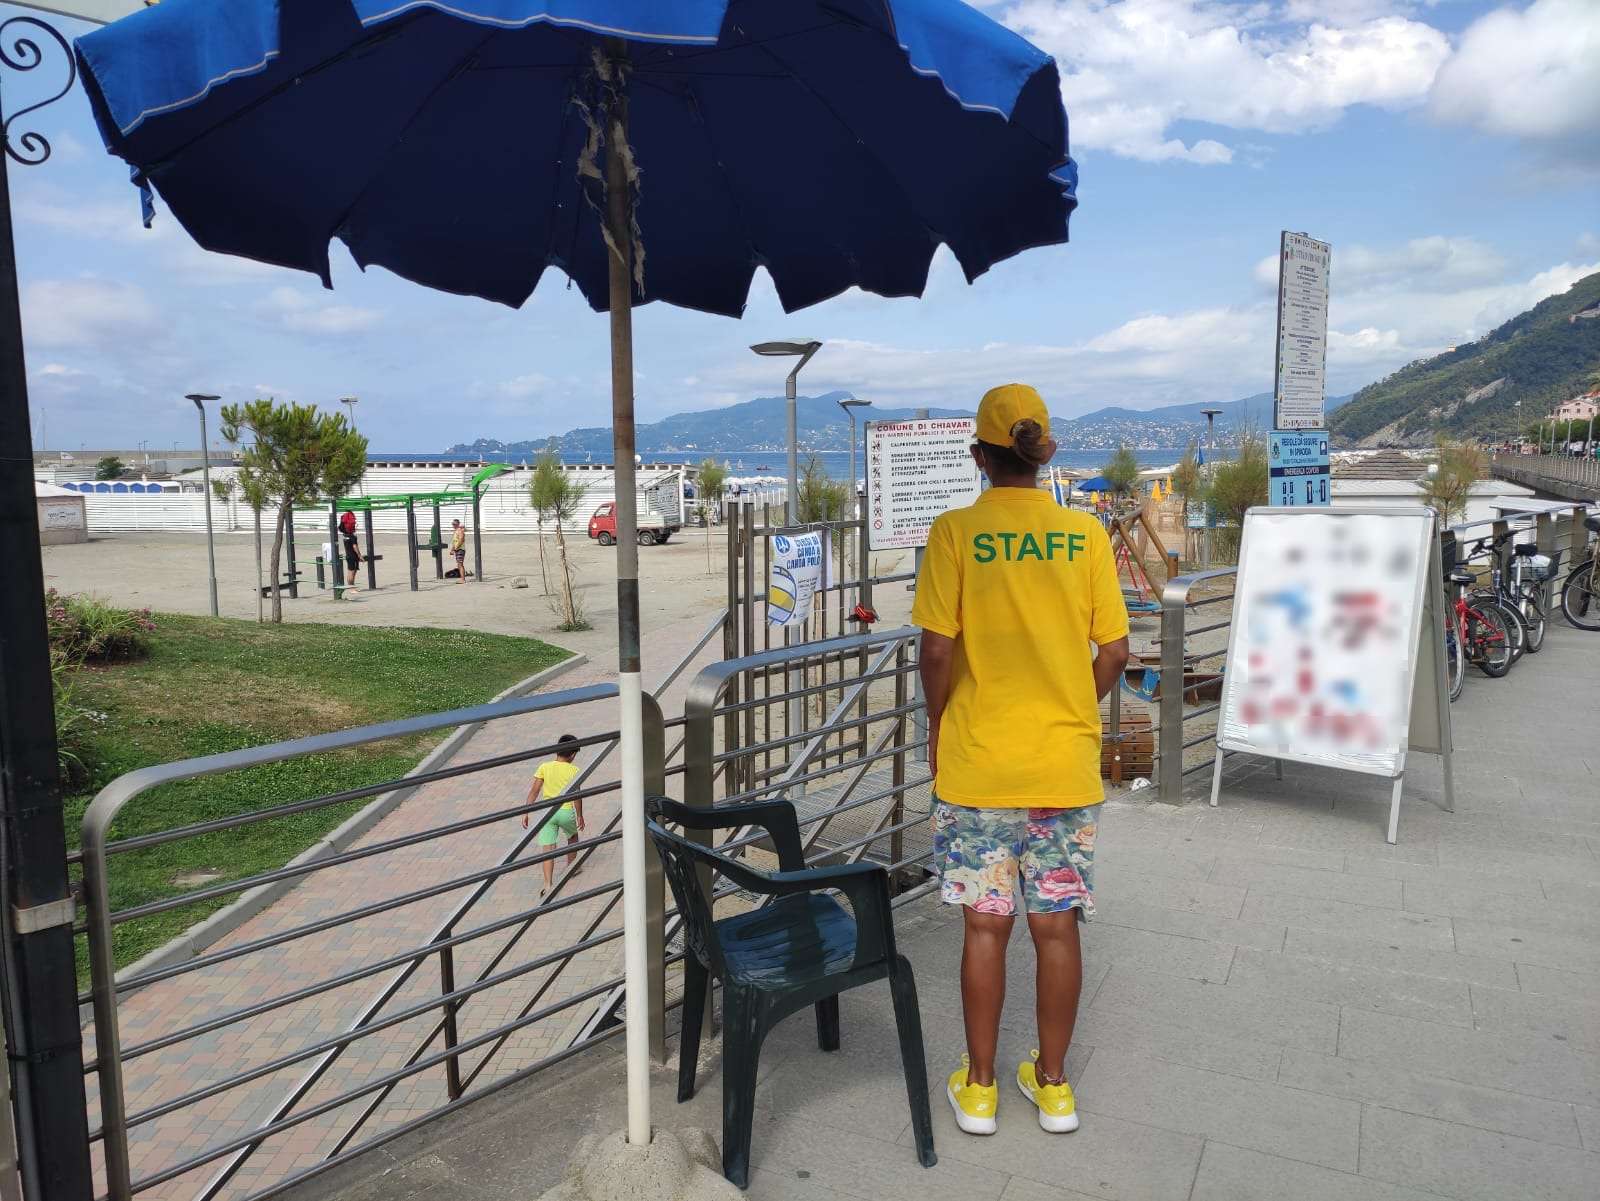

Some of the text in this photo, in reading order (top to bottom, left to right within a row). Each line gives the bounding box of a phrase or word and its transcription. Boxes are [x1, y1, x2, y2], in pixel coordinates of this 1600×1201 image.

[877, 423, 914, 432] COMUNE
[931, 421, 971, 429] CHIAVARI
[973, 533, 1086, 563] STAFF
